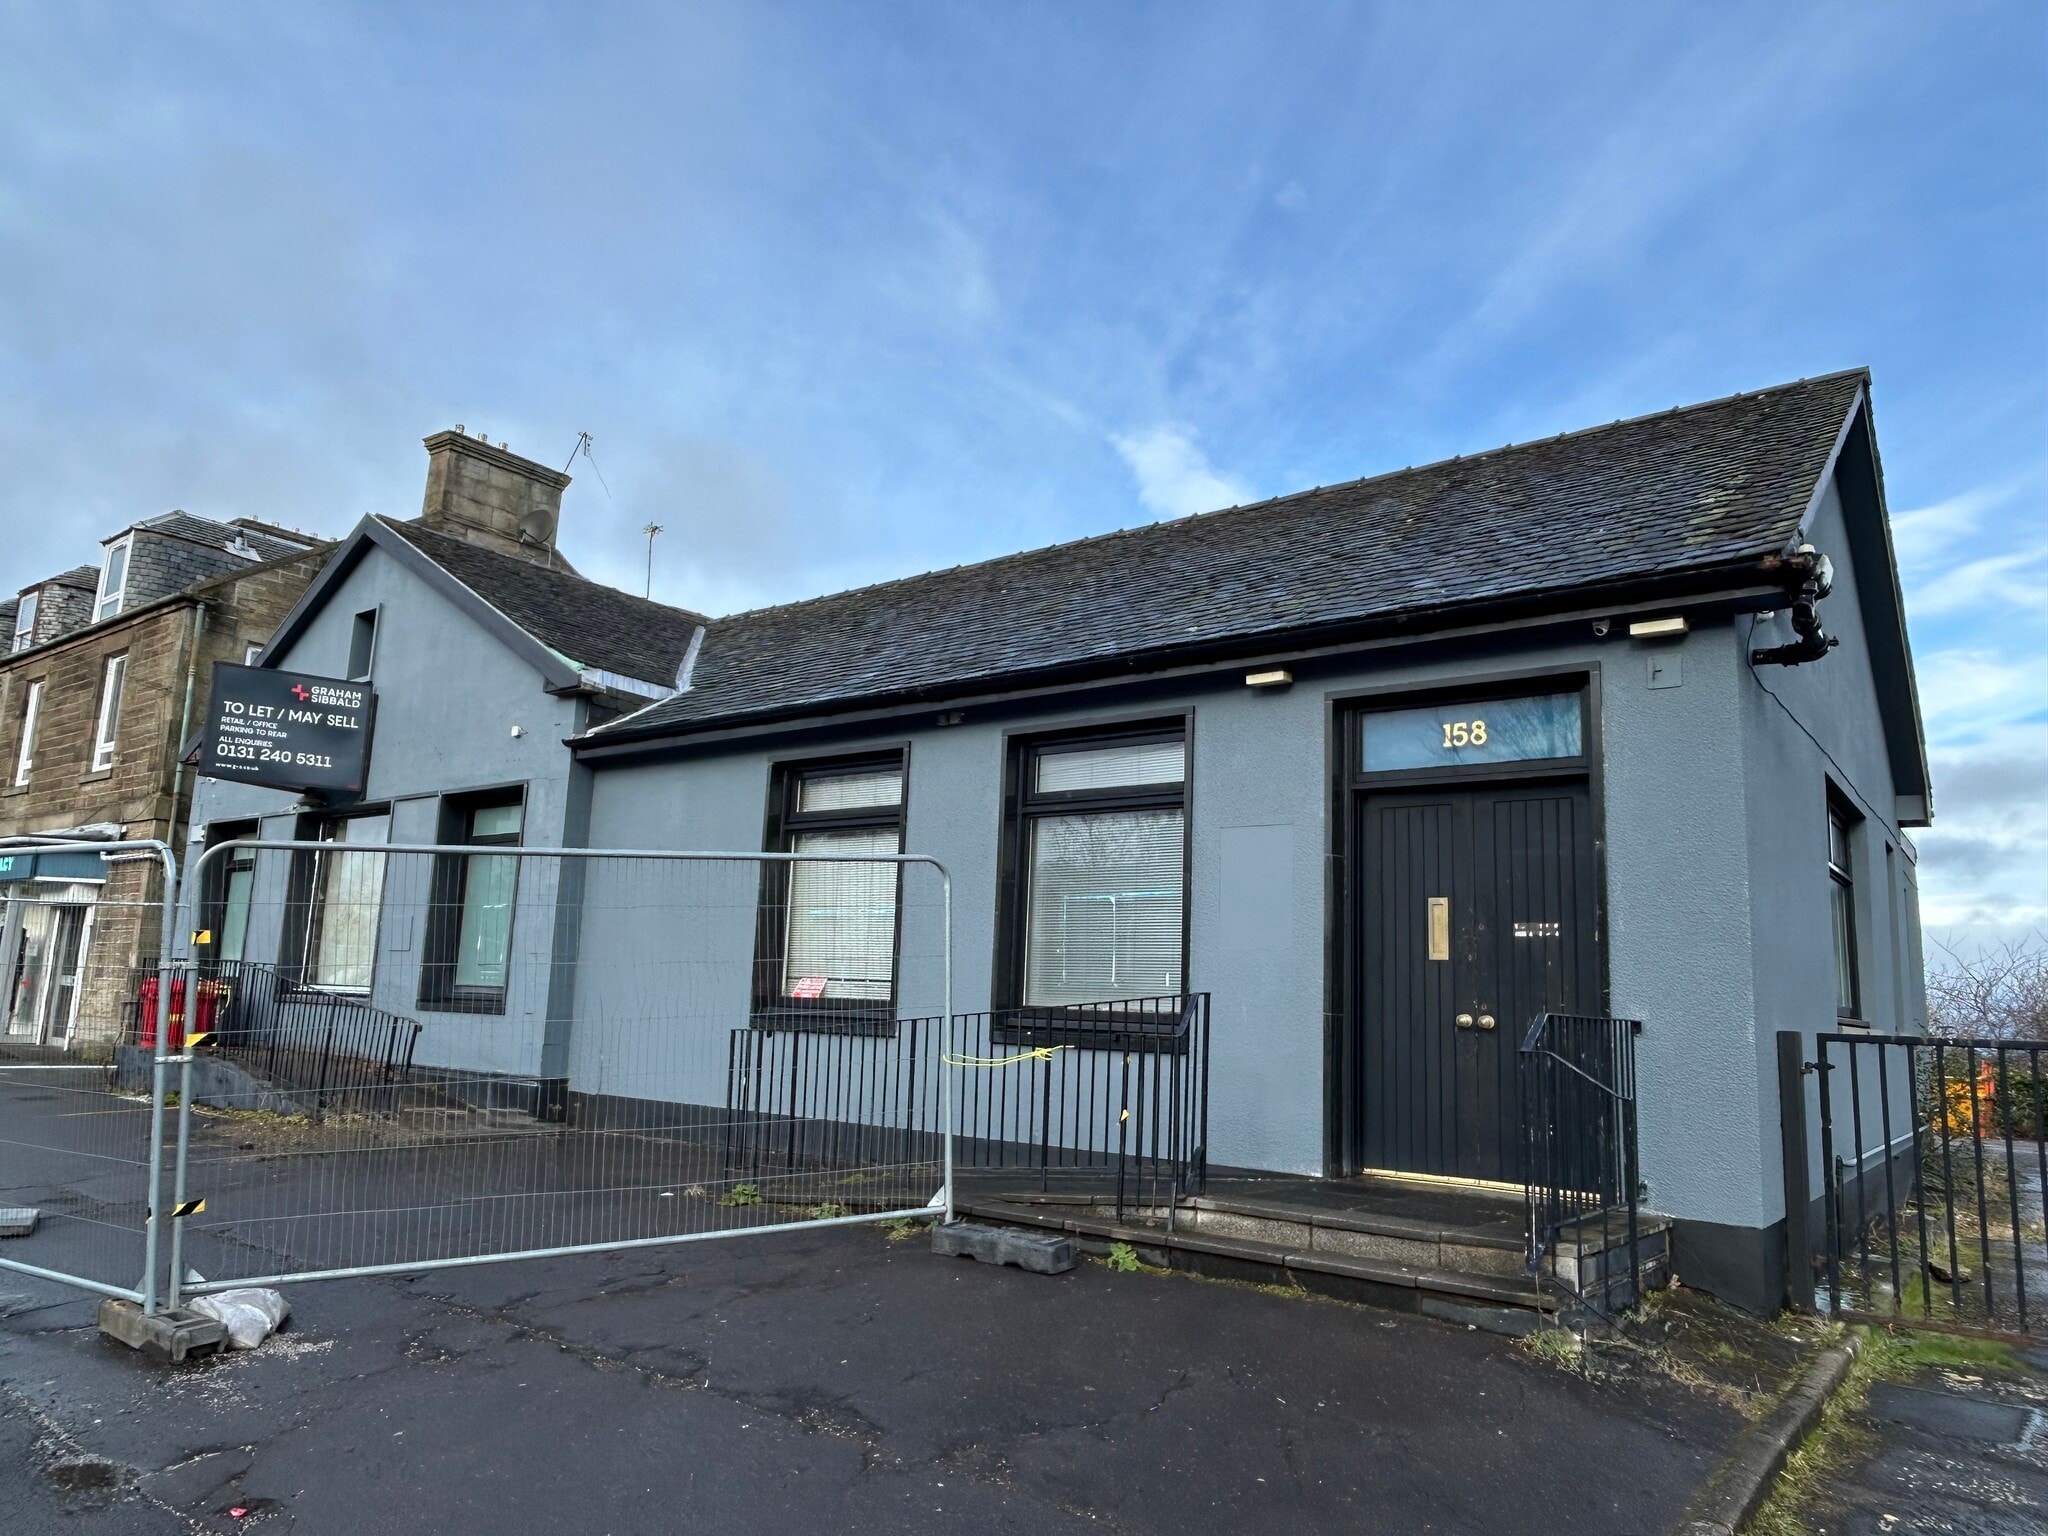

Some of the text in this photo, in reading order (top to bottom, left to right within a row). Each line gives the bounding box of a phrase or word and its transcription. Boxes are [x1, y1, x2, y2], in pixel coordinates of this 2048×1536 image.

[311, 686, 362, 700] GRAHAM
[311, 694, 361, 709] SIBBALD
[223, 701, 359, 729] TO LET / MAY SELL
[221, 716, 245, 725] RETAIL
[253, 720, 278, 729] OFFICE
[219, 724, 287, 738] PARKING TO REAR
[1442, 720, 1487, 748] 158
[219, 735, 273, 747] ALL ENQUIRIES
[217, 743, 332, 768] 0131 240 5311
